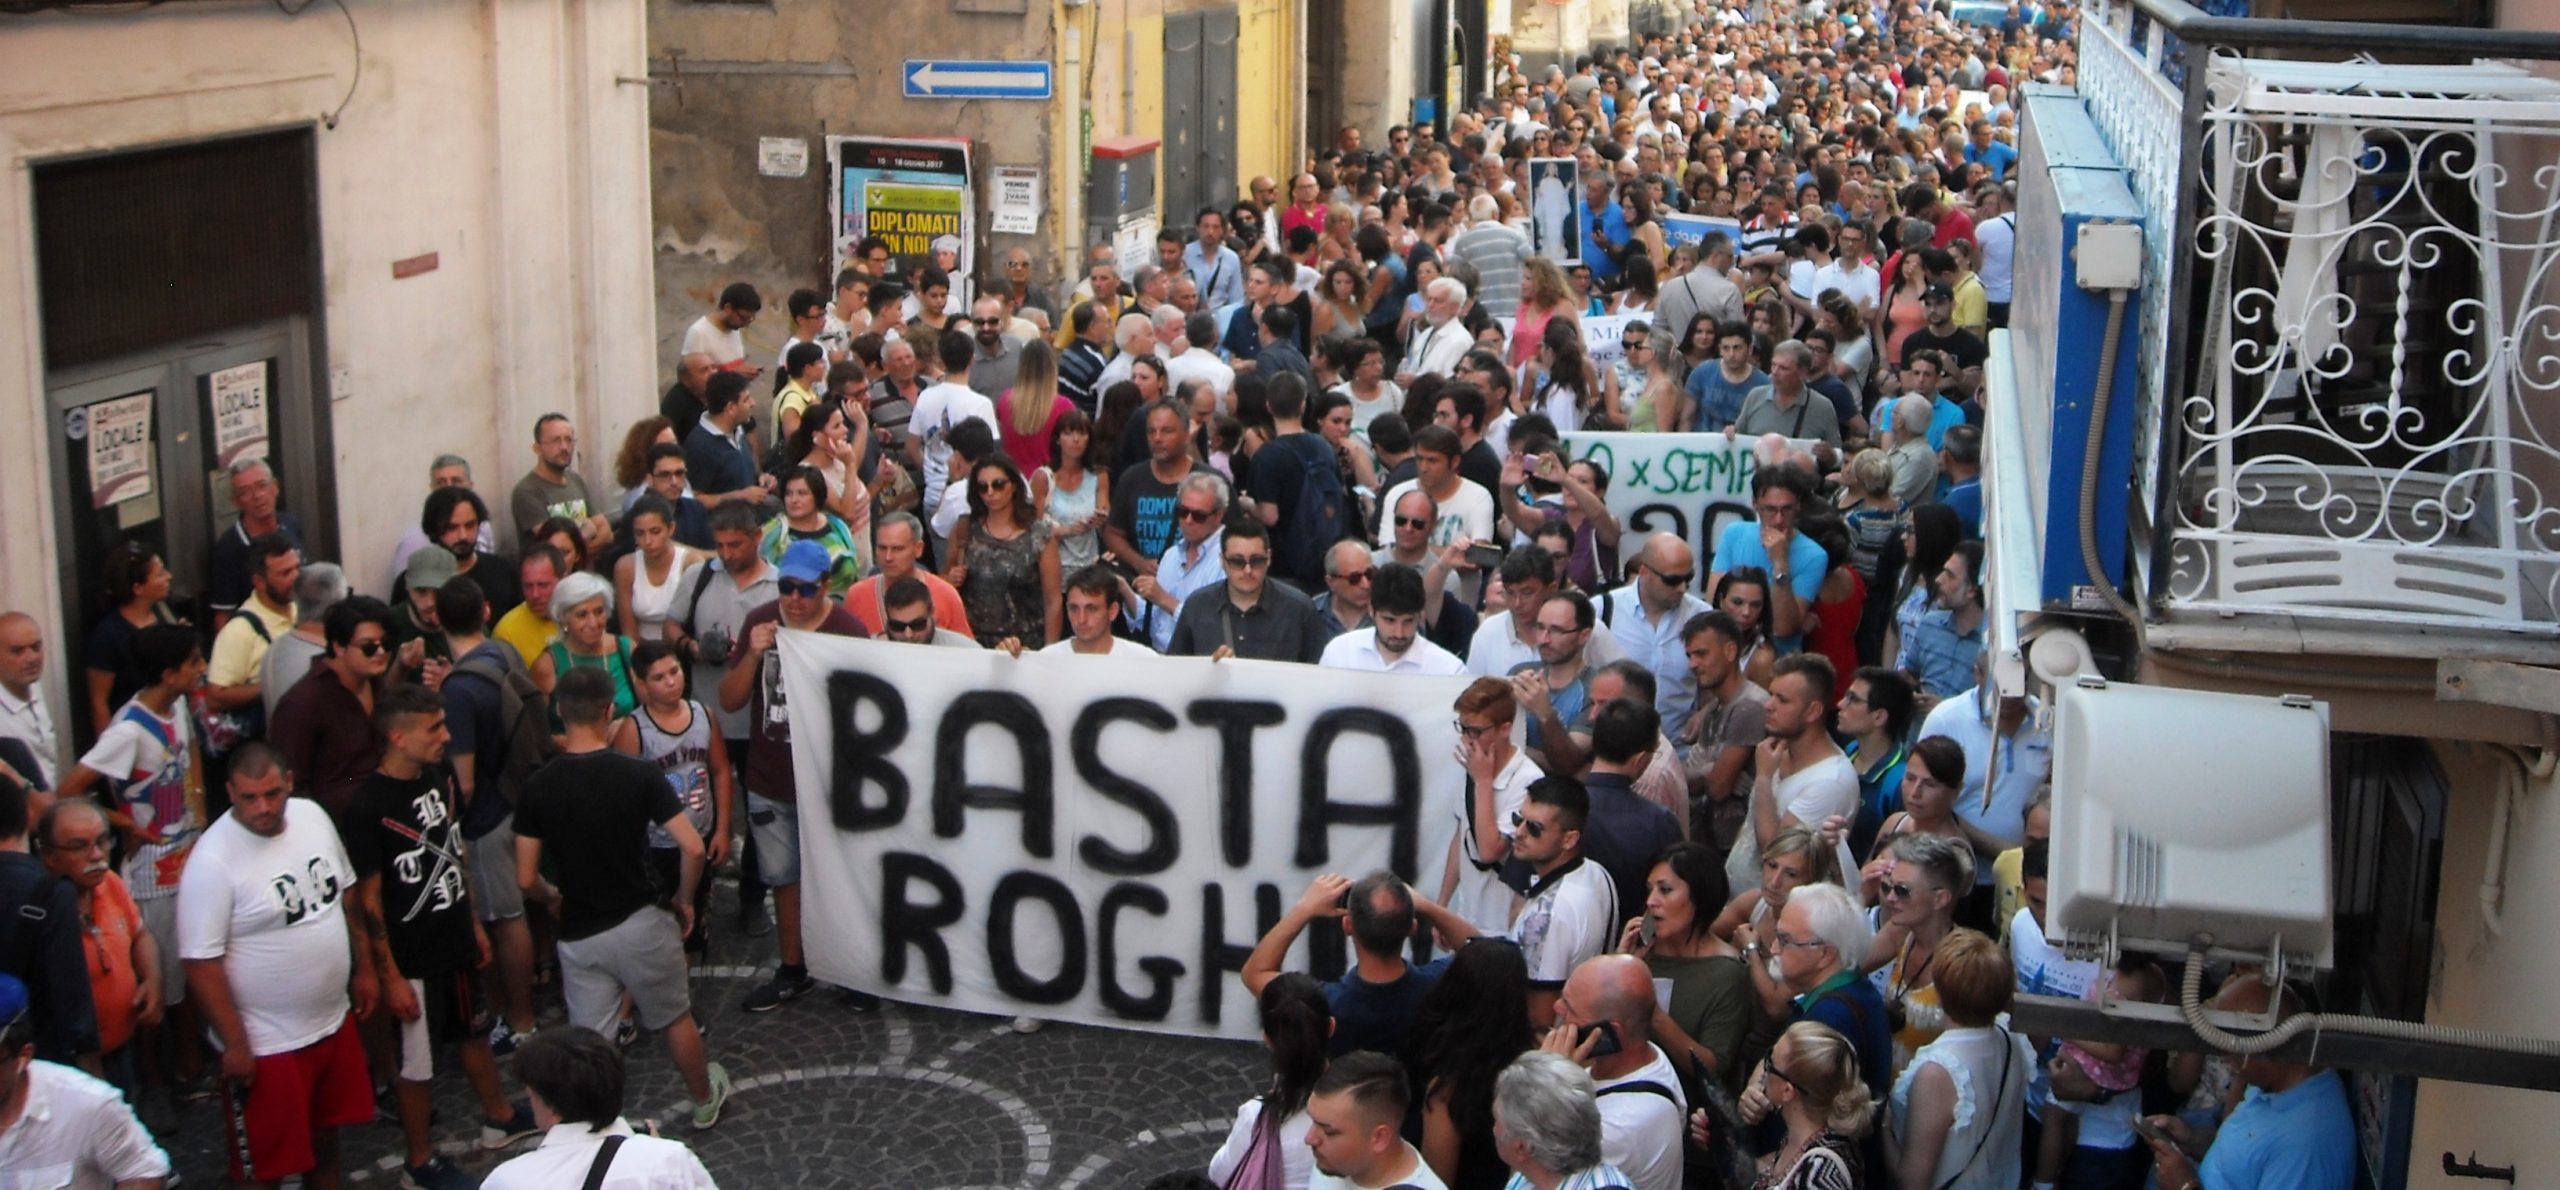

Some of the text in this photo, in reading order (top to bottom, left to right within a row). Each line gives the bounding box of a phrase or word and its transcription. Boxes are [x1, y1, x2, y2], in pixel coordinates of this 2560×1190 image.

[869, 210, 959, 234] DIPLOMATI
[870, 232, 929, 255] ON NOI
[219, 387, 260, 417] LOCALE
[96, 421, 143, 453] LOCALE
[1653, 448, 1757, 495] SEMP
[1137, 496, 1177, 516] DOMY
[826, 669, 1422, 886] BASTA
